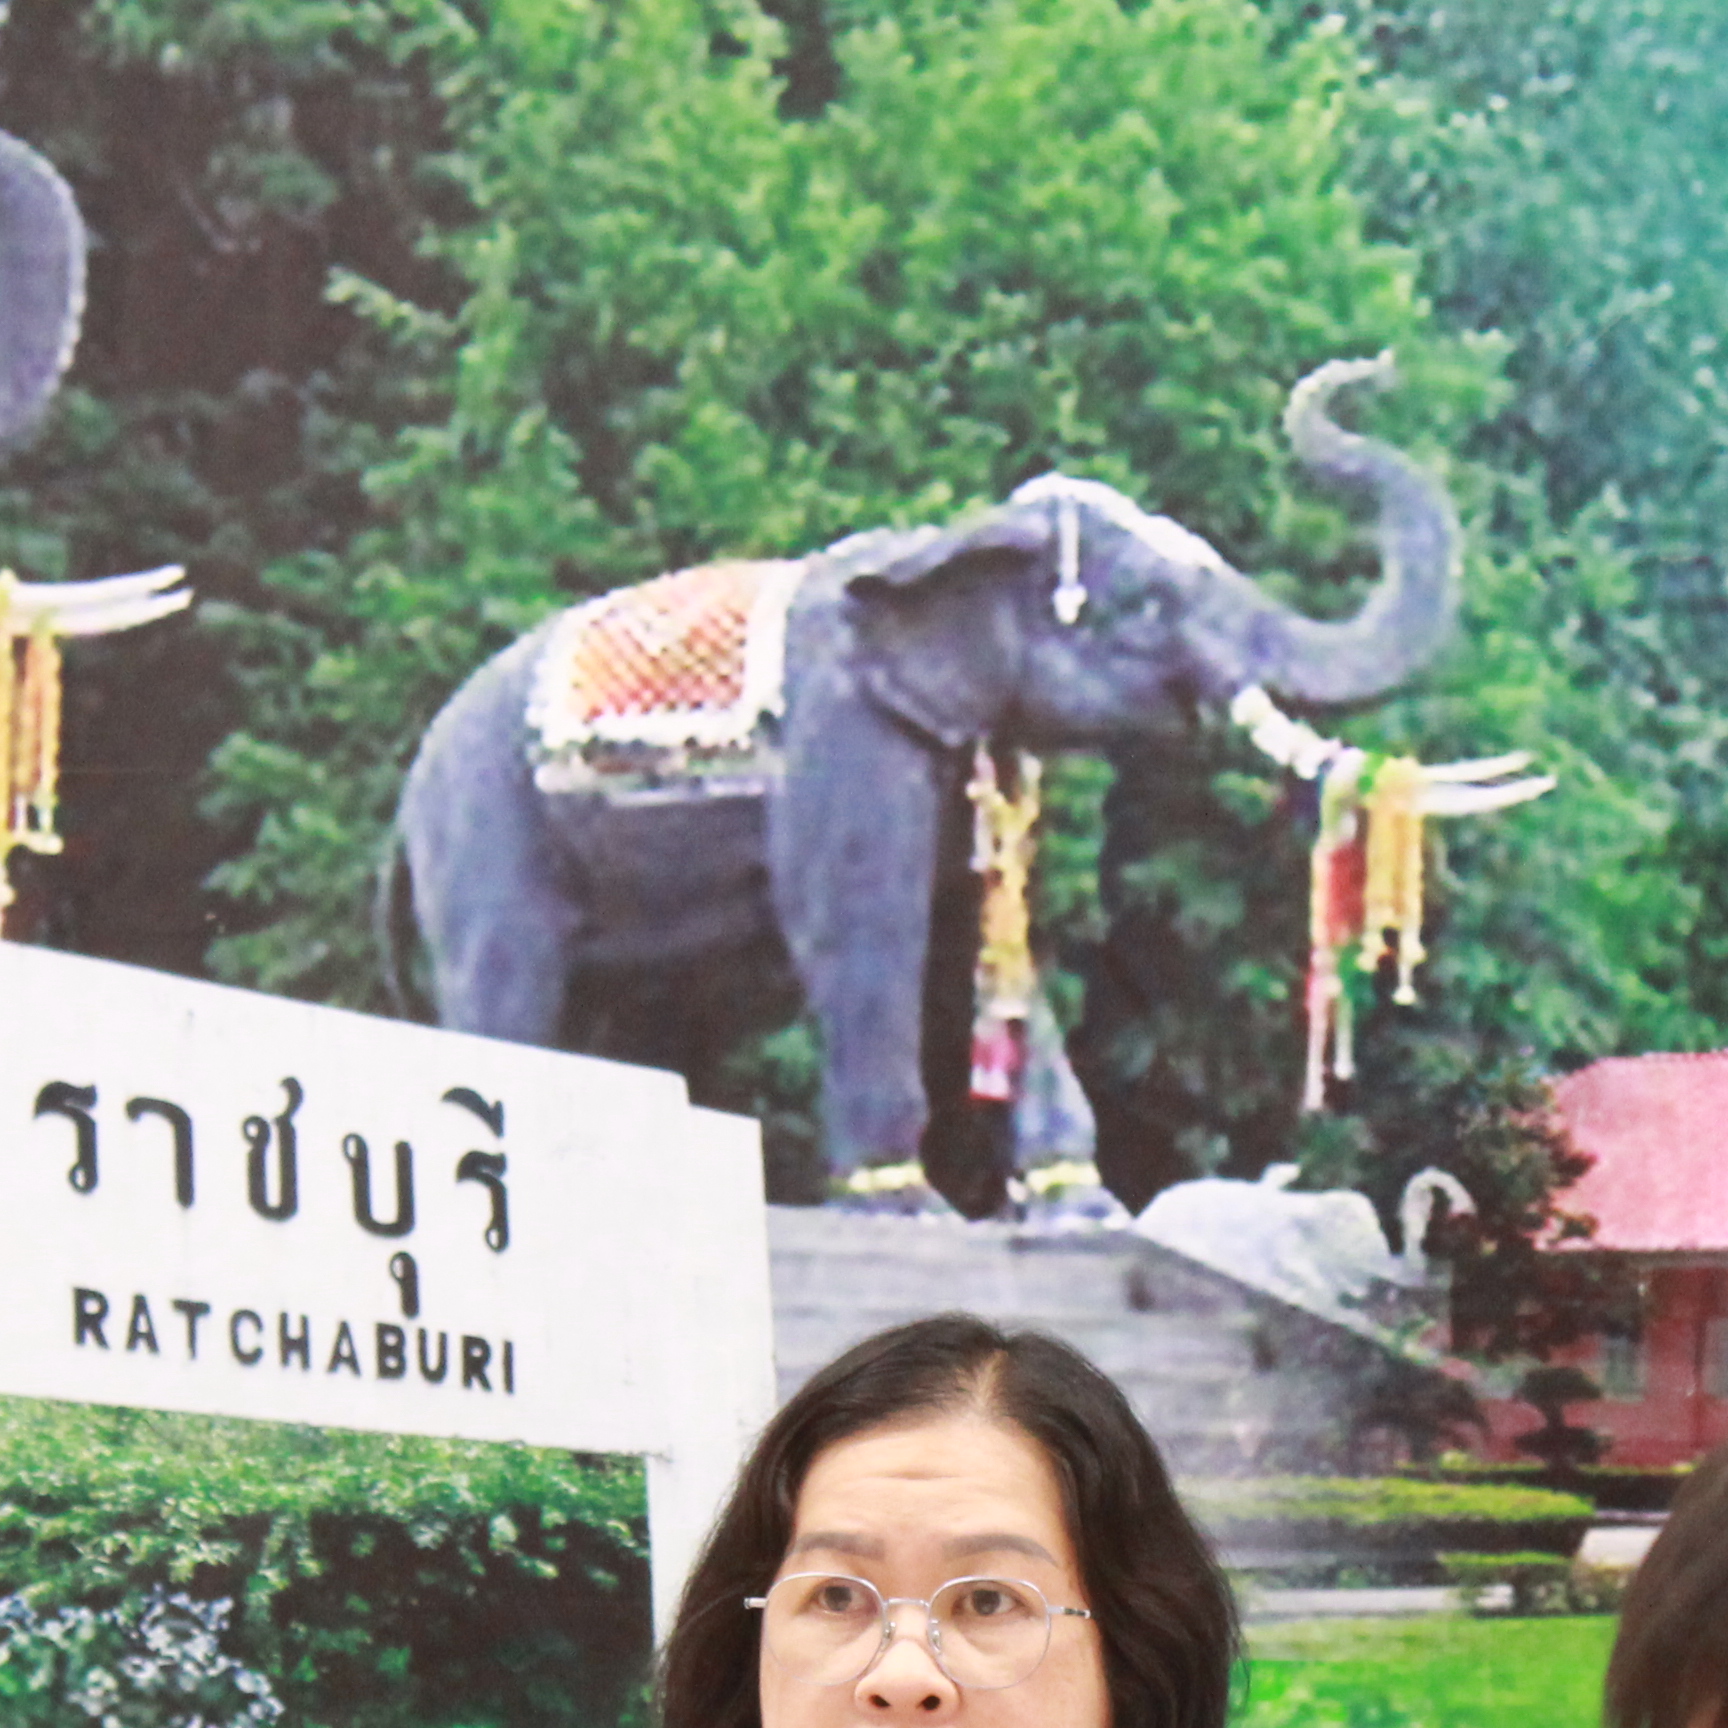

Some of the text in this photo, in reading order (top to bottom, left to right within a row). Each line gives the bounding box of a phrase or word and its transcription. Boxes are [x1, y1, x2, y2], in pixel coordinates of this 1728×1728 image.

[32, 1076, 510, 1319] ราชบุรี
[72, 1285, 515, 1395] RATCHABURI
